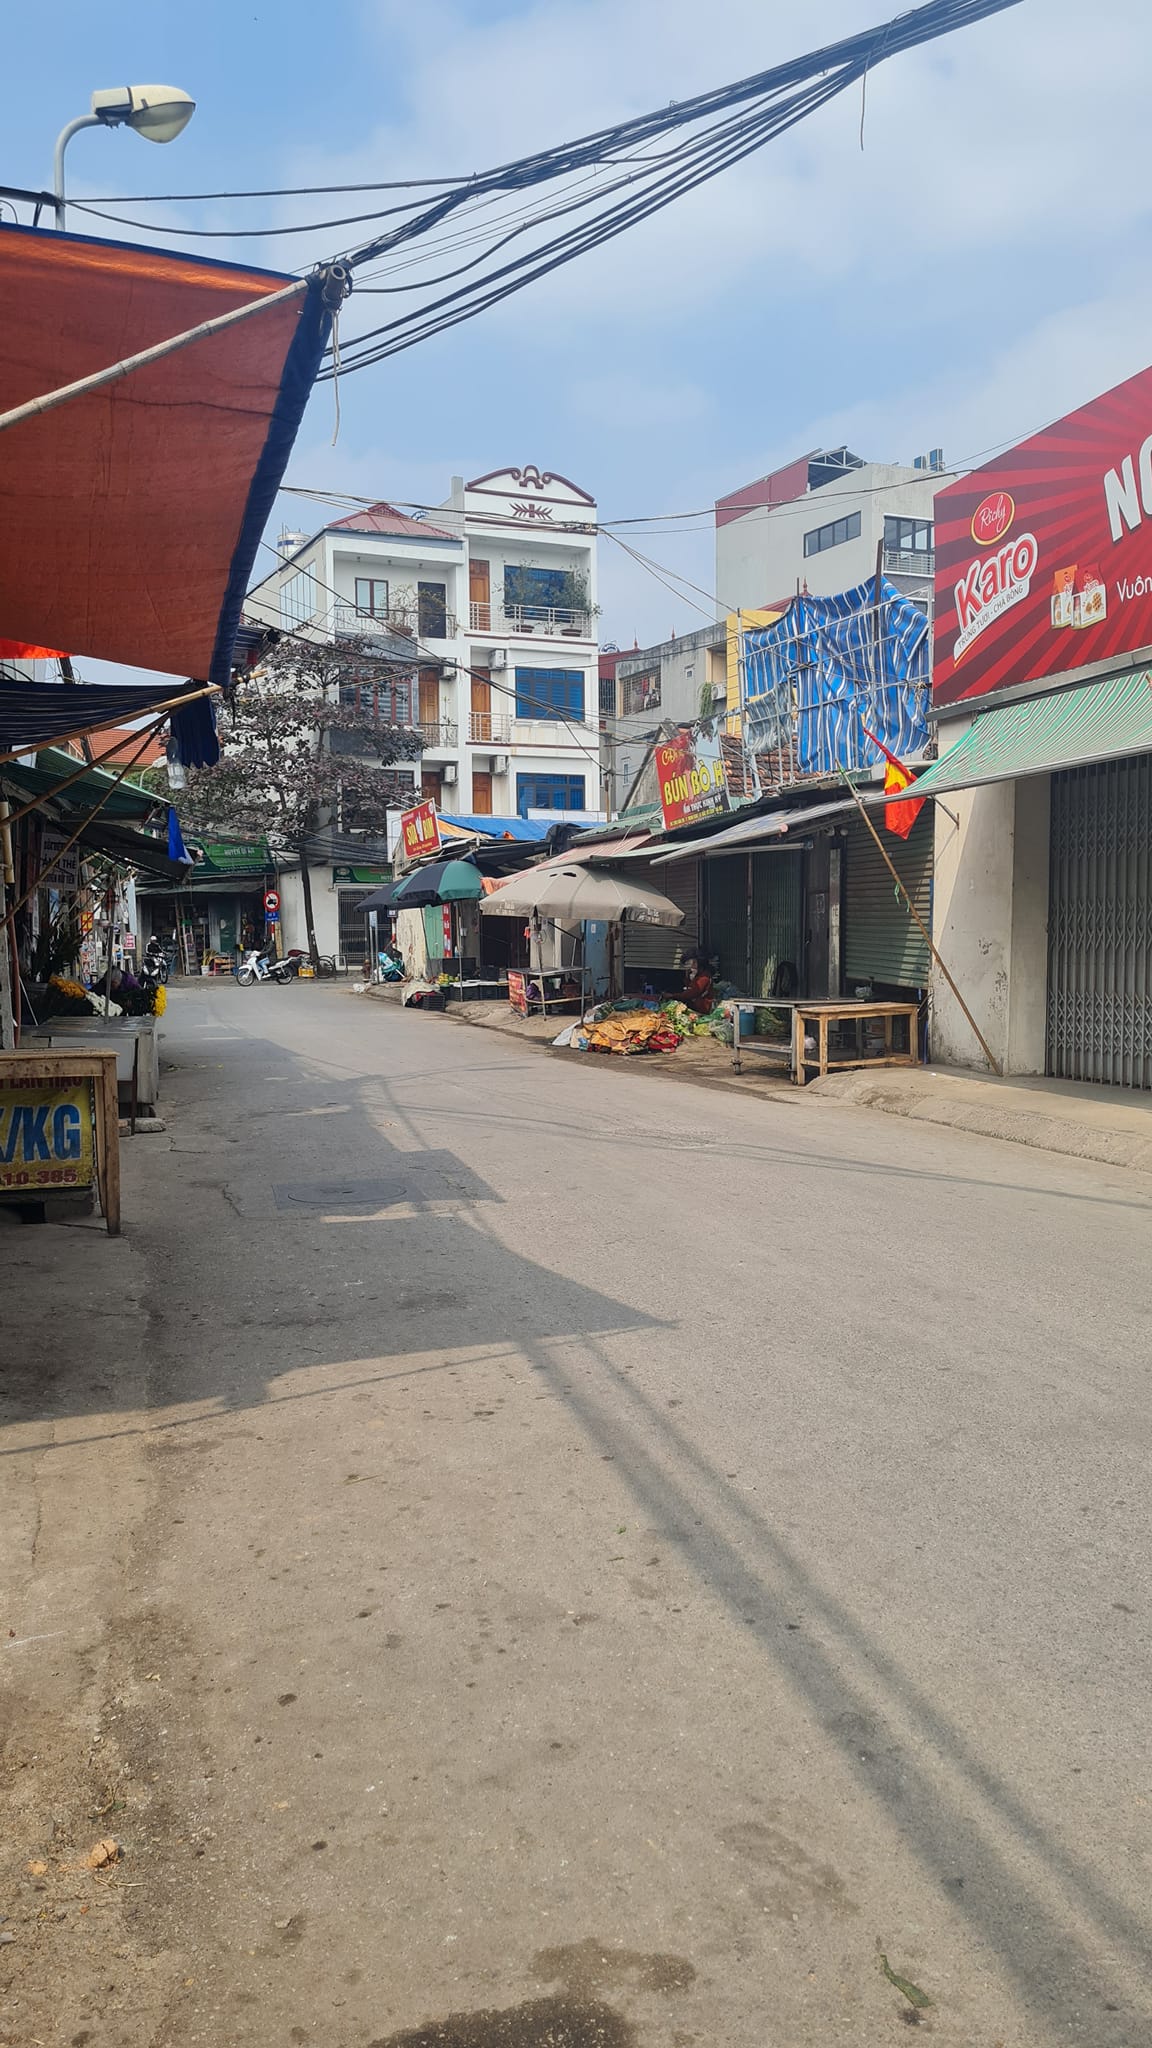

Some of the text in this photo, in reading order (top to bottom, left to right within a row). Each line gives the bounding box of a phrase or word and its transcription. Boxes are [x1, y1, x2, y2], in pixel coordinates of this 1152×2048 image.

[978, 495, 1006, 533] Richy
[954, 533, 1037, 632] Karo
[663, 772, 689, 806] BÚN
[690, 759, 711, 796] BÒ
